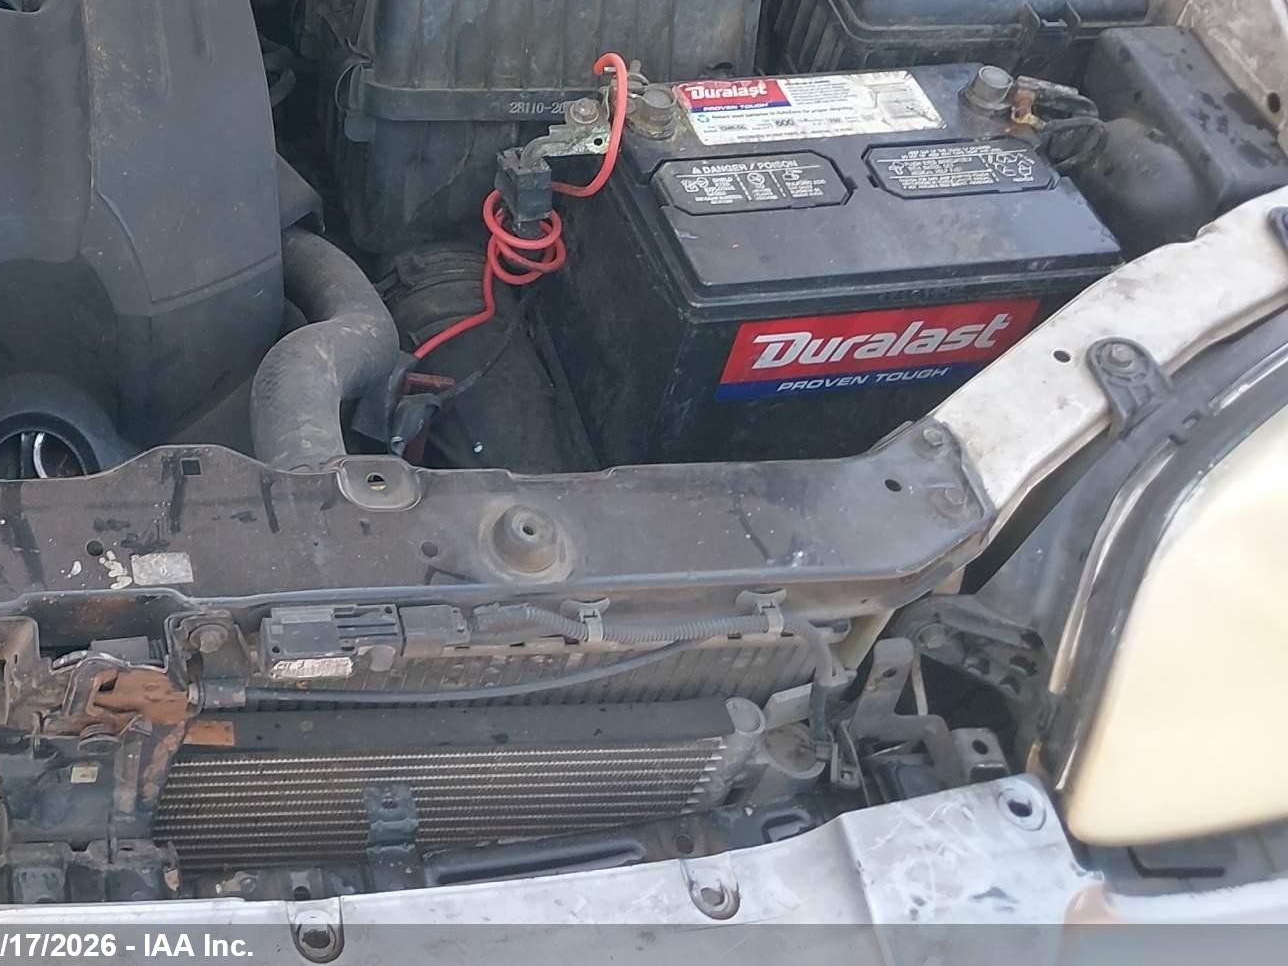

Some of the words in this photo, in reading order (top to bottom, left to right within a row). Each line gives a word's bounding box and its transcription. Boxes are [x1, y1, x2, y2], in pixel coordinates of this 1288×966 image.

[685, 80, 767, 100] Duralast
[752, 313, 1011, 370] Duralast
[777, 375, 866, 391] PROVEN
[875, 366, 951, 382] TOUGH
